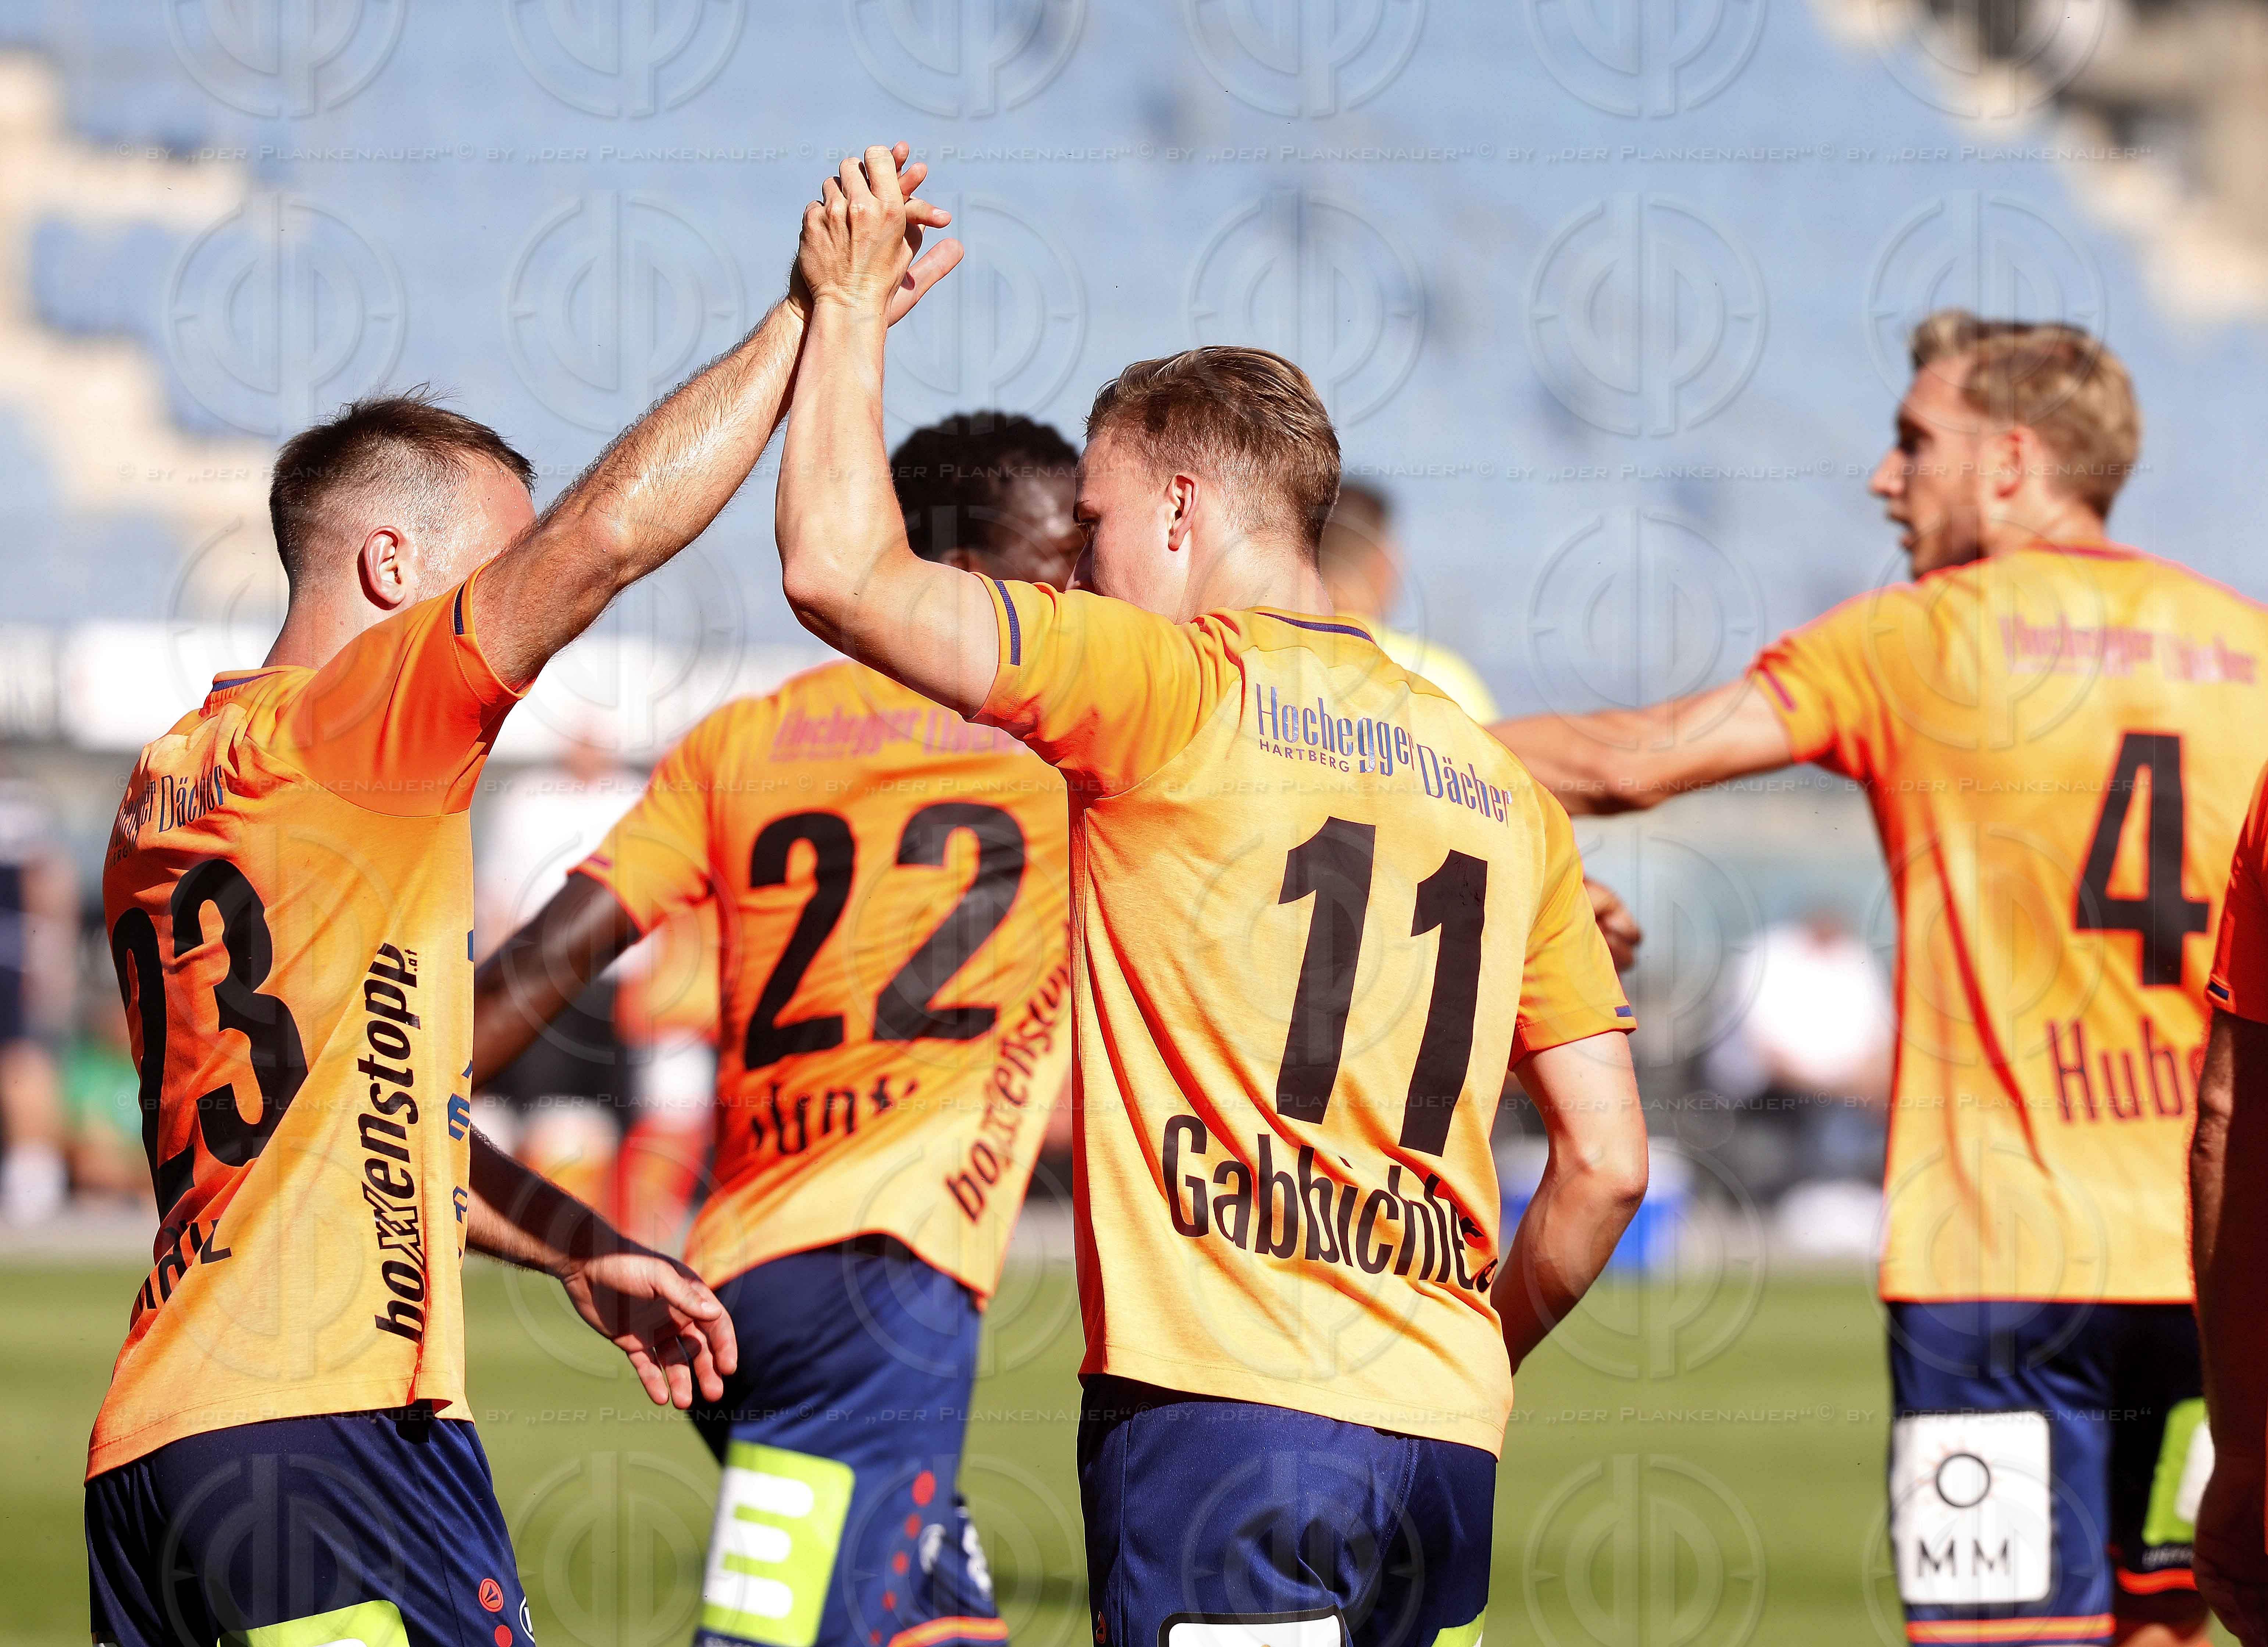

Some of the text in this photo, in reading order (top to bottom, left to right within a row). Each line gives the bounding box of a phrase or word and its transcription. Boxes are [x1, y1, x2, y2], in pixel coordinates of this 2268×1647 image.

[1256, 683, 1512, 827] Hochegger Dächer
[1259, 739, 1349, 772] HARTBERG
[2075, 732, 2210, 987] 4
[112, 858, 309, 1224] 23
[744, 801, 1026, 1071] 22
[1276, 816, 1488, 1157] 11
